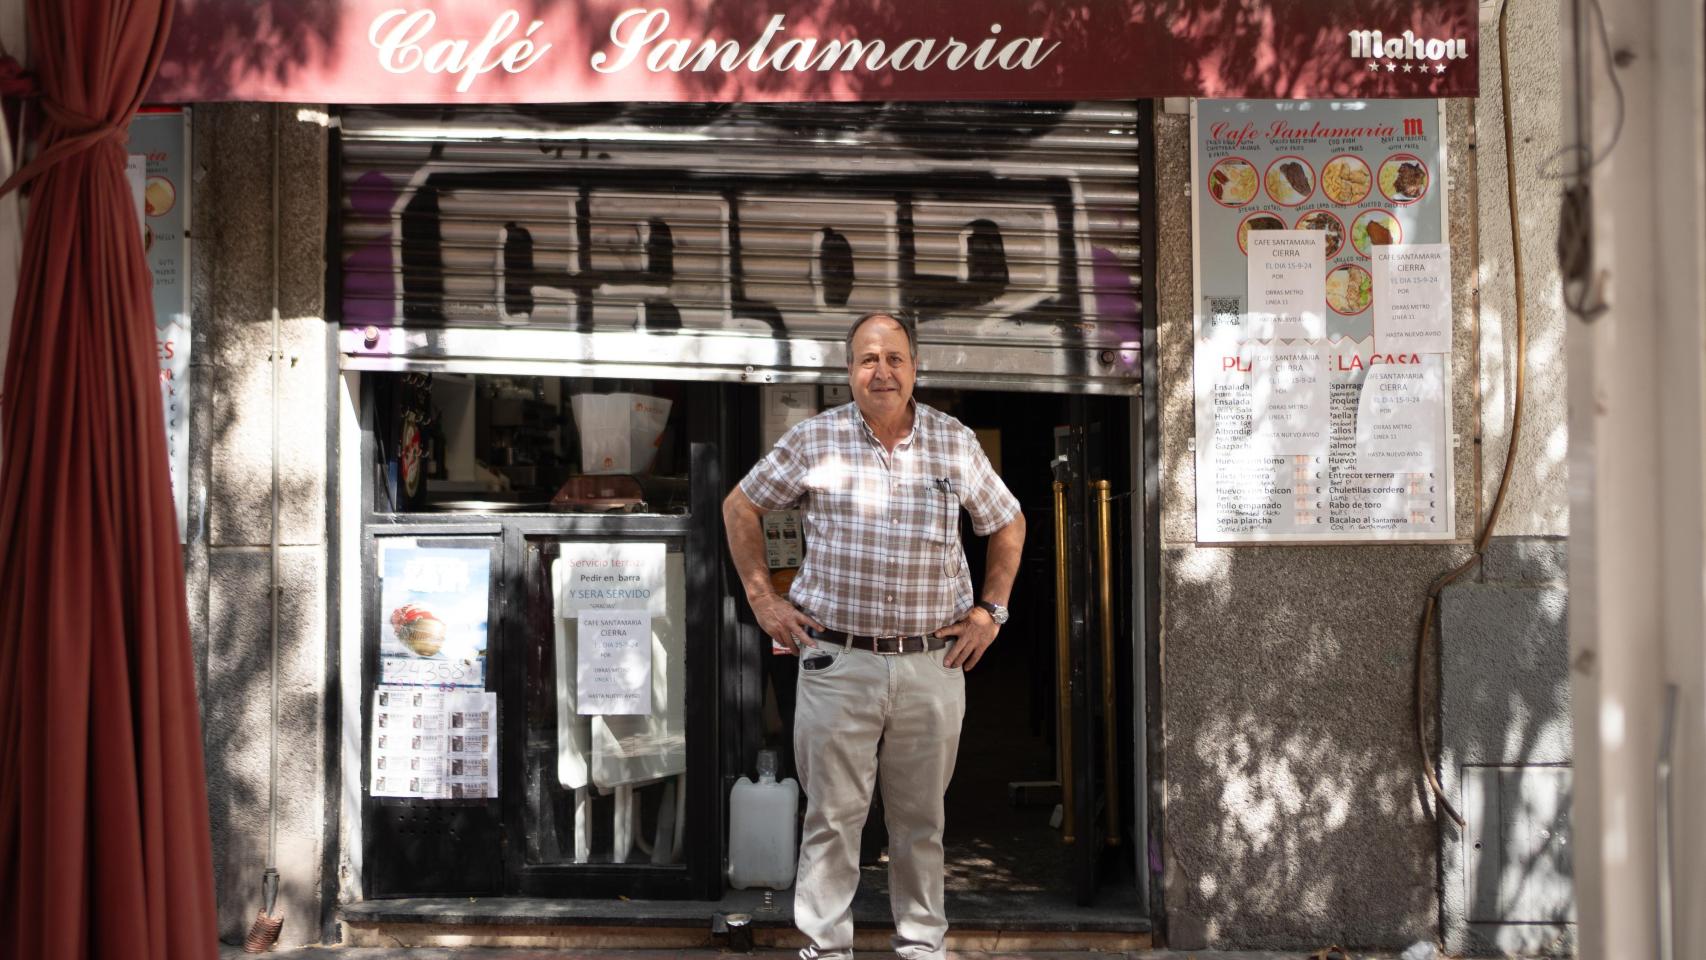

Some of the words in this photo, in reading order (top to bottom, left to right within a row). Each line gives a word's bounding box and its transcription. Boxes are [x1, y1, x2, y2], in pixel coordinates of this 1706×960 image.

[1348, 29, 1469, 60] Mahou
[368, 9, 552, 93] Café
[591, 8, 1061, 74] Santamaria
[1265, 120, 1398, 138] Santamaria
[1272, 249, 1301, 257] CIERRA
[1397, 264, 1426, 272] CIERRA
[1338, 354, 1364, 371] LA
[1379, 383, 1408, 391] CIERRA
[1264, 487, 1292, 495] beicon
[1328, 485, 1371, 494] Chuletillas
[1372, 485, 1405, 494] cordero
[1216, 502, 1237, 510] Pollo
[1238, 502, 1282, 512] empanado
[1329, 501, 1350, 509] Rabo
[1352, 501, 1362, 509] de
[1216, 517, 1239, 526] Sepia
[1240, 517, 1273, 526] plancha
[1329, 516, 1361, 524] Bacalao
[1363, 516, 1371, 524] al
[580, 574, 601, 583] Pedir
[618, 574, 641, 583] barra
[569, 590, 577, 598] Y
[578, 589, 604, 599] SERA
[606, 588, 651, 599] SERVIDO
